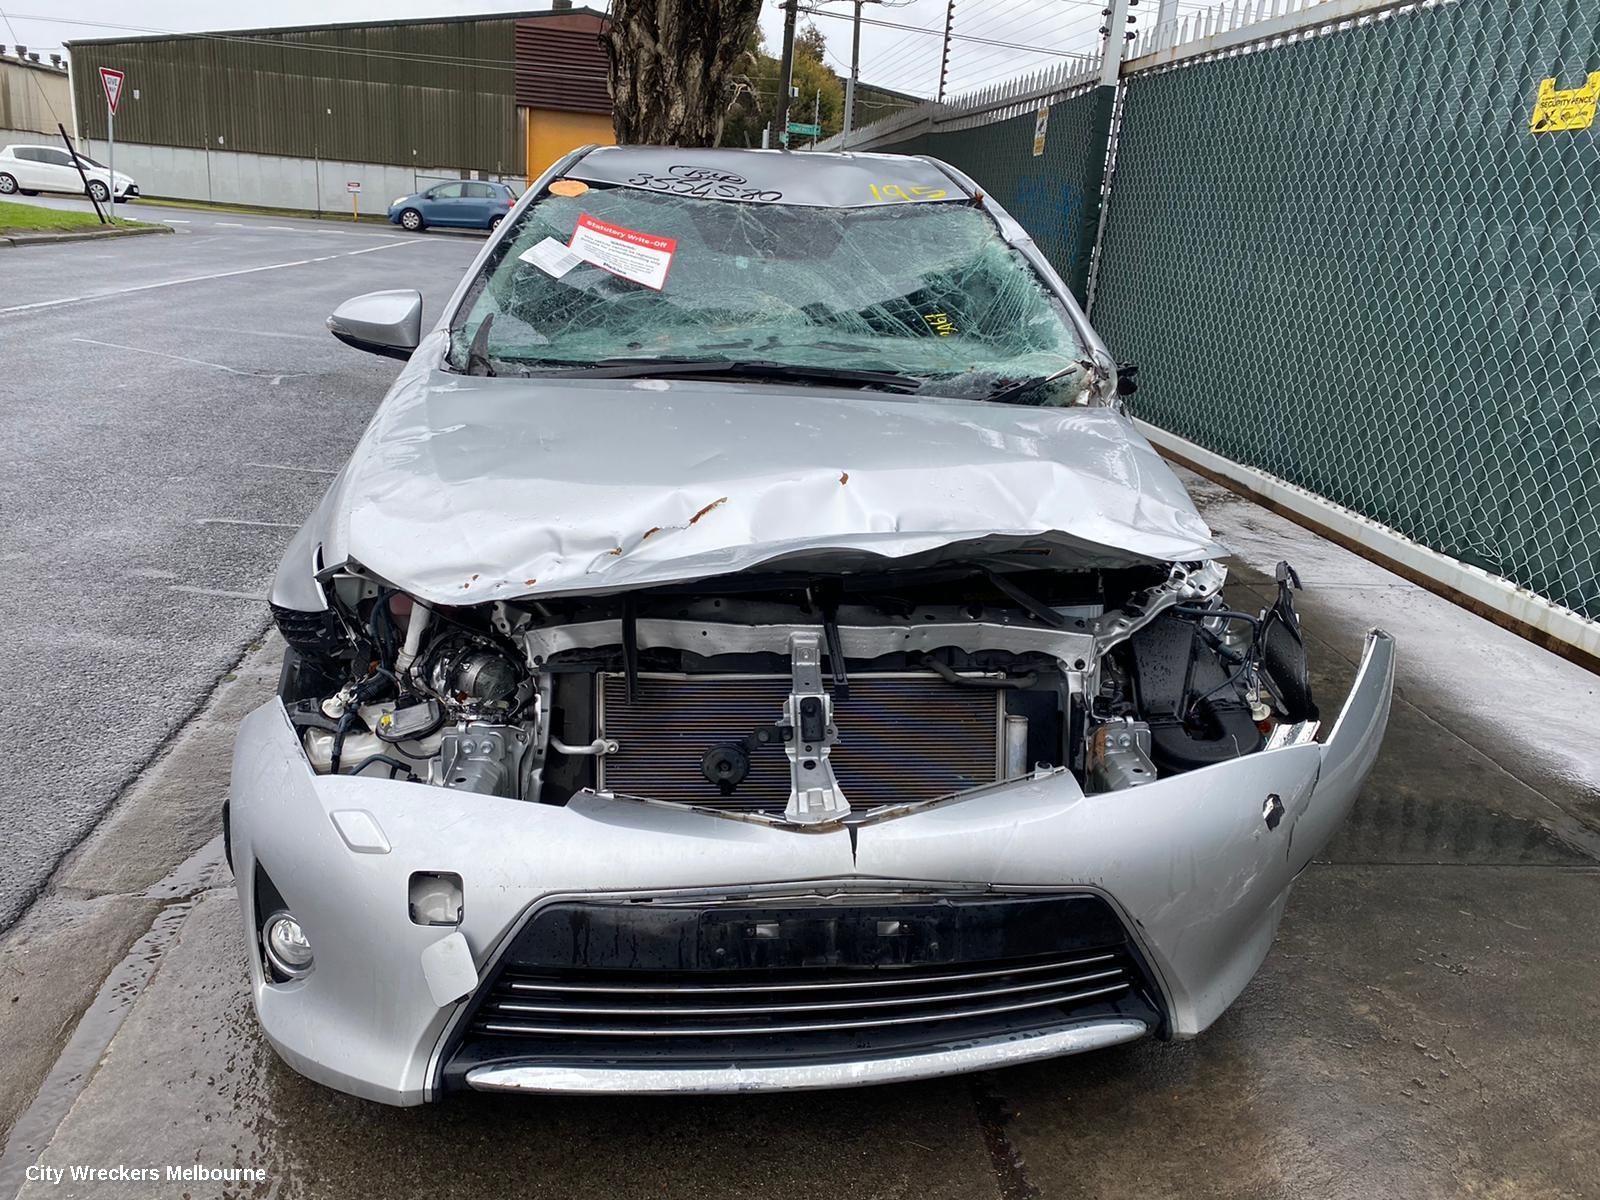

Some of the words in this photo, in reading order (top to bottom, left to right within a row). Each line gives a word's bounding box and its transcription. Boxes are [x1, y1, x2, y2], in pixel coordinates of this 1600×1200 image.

[869, 183, 946, 202] 195
[586, 220, 626, 239] Statutory
[627, 233, 668, 249] Write-Off
